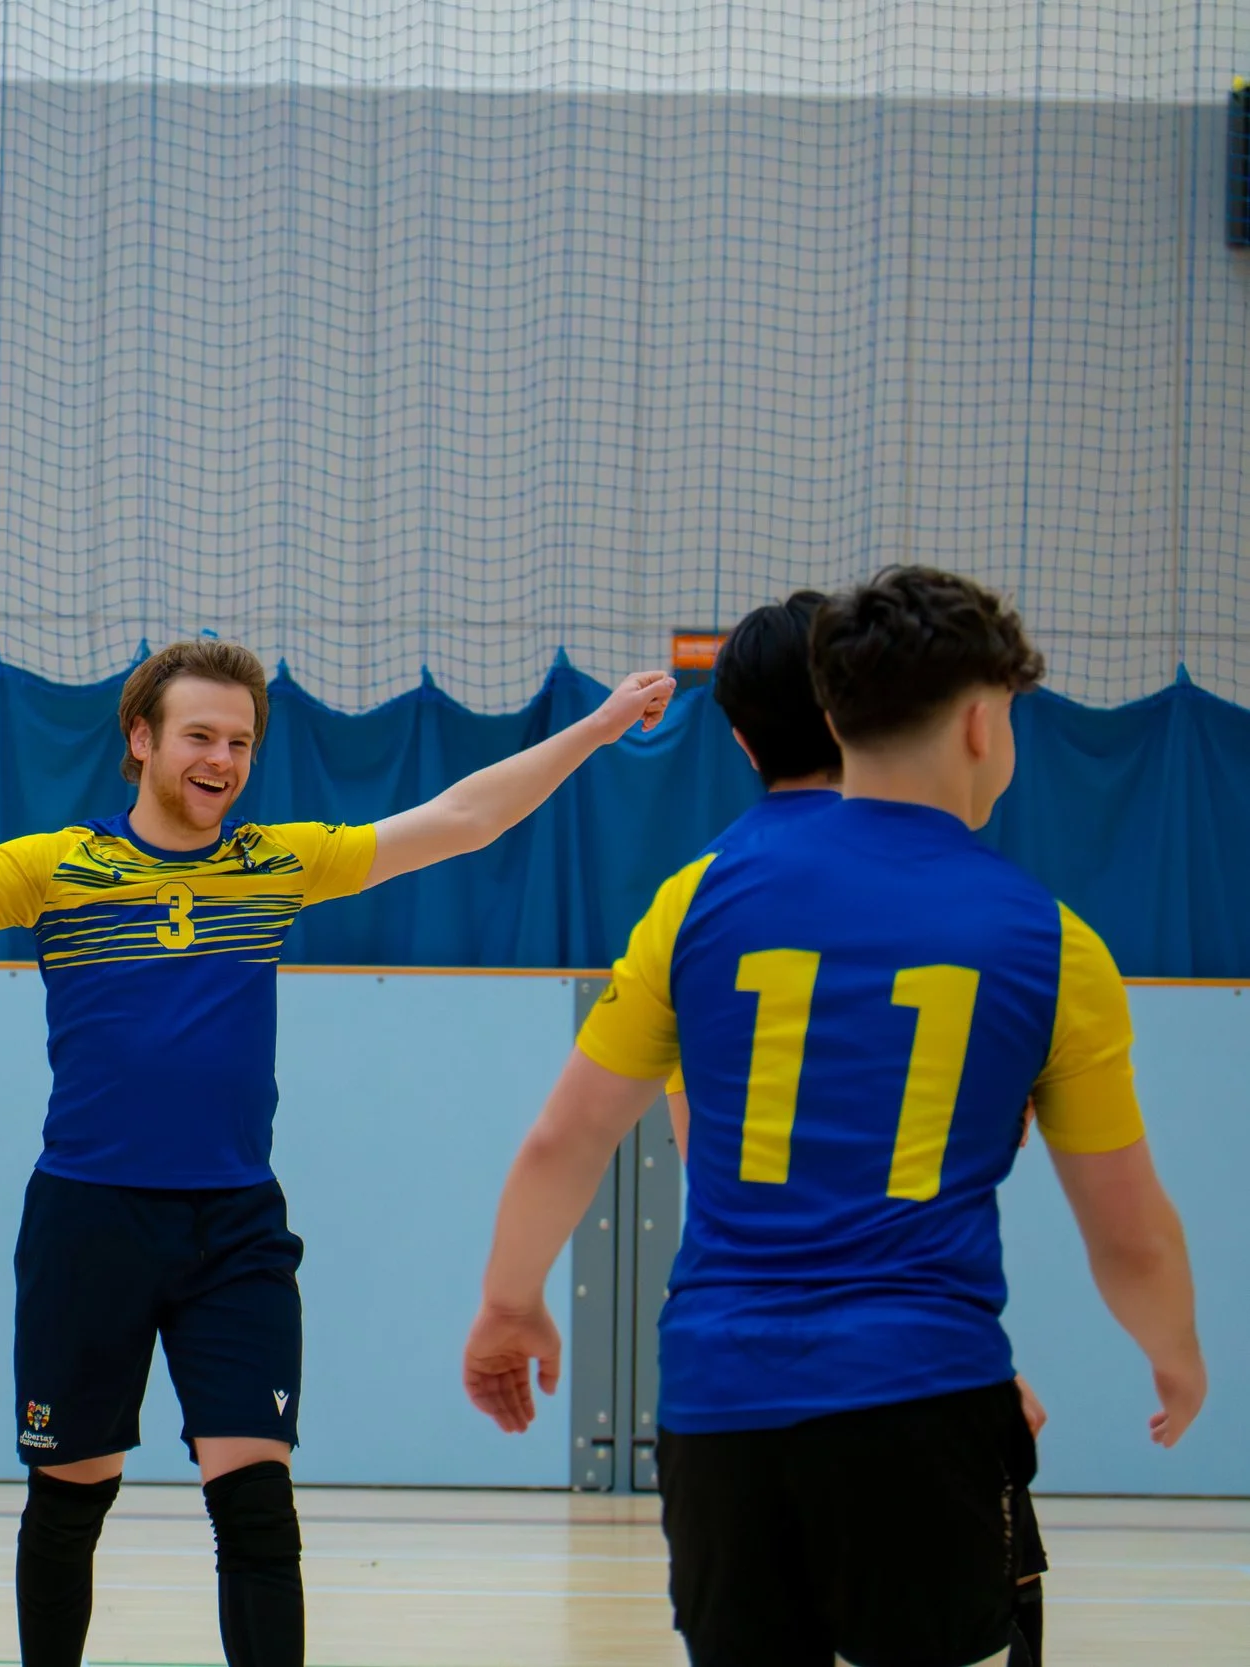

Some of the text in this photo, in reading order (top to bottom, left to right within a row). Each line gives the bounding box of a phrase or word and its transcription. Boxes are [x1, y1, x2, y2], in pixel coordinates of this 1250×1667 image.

[155, 882, 196, 950] 3
[735, 948, 981, 1202] 11
[20, 1435, 58, 1449] University
[22, 1430, 54, 1443] Abertay
